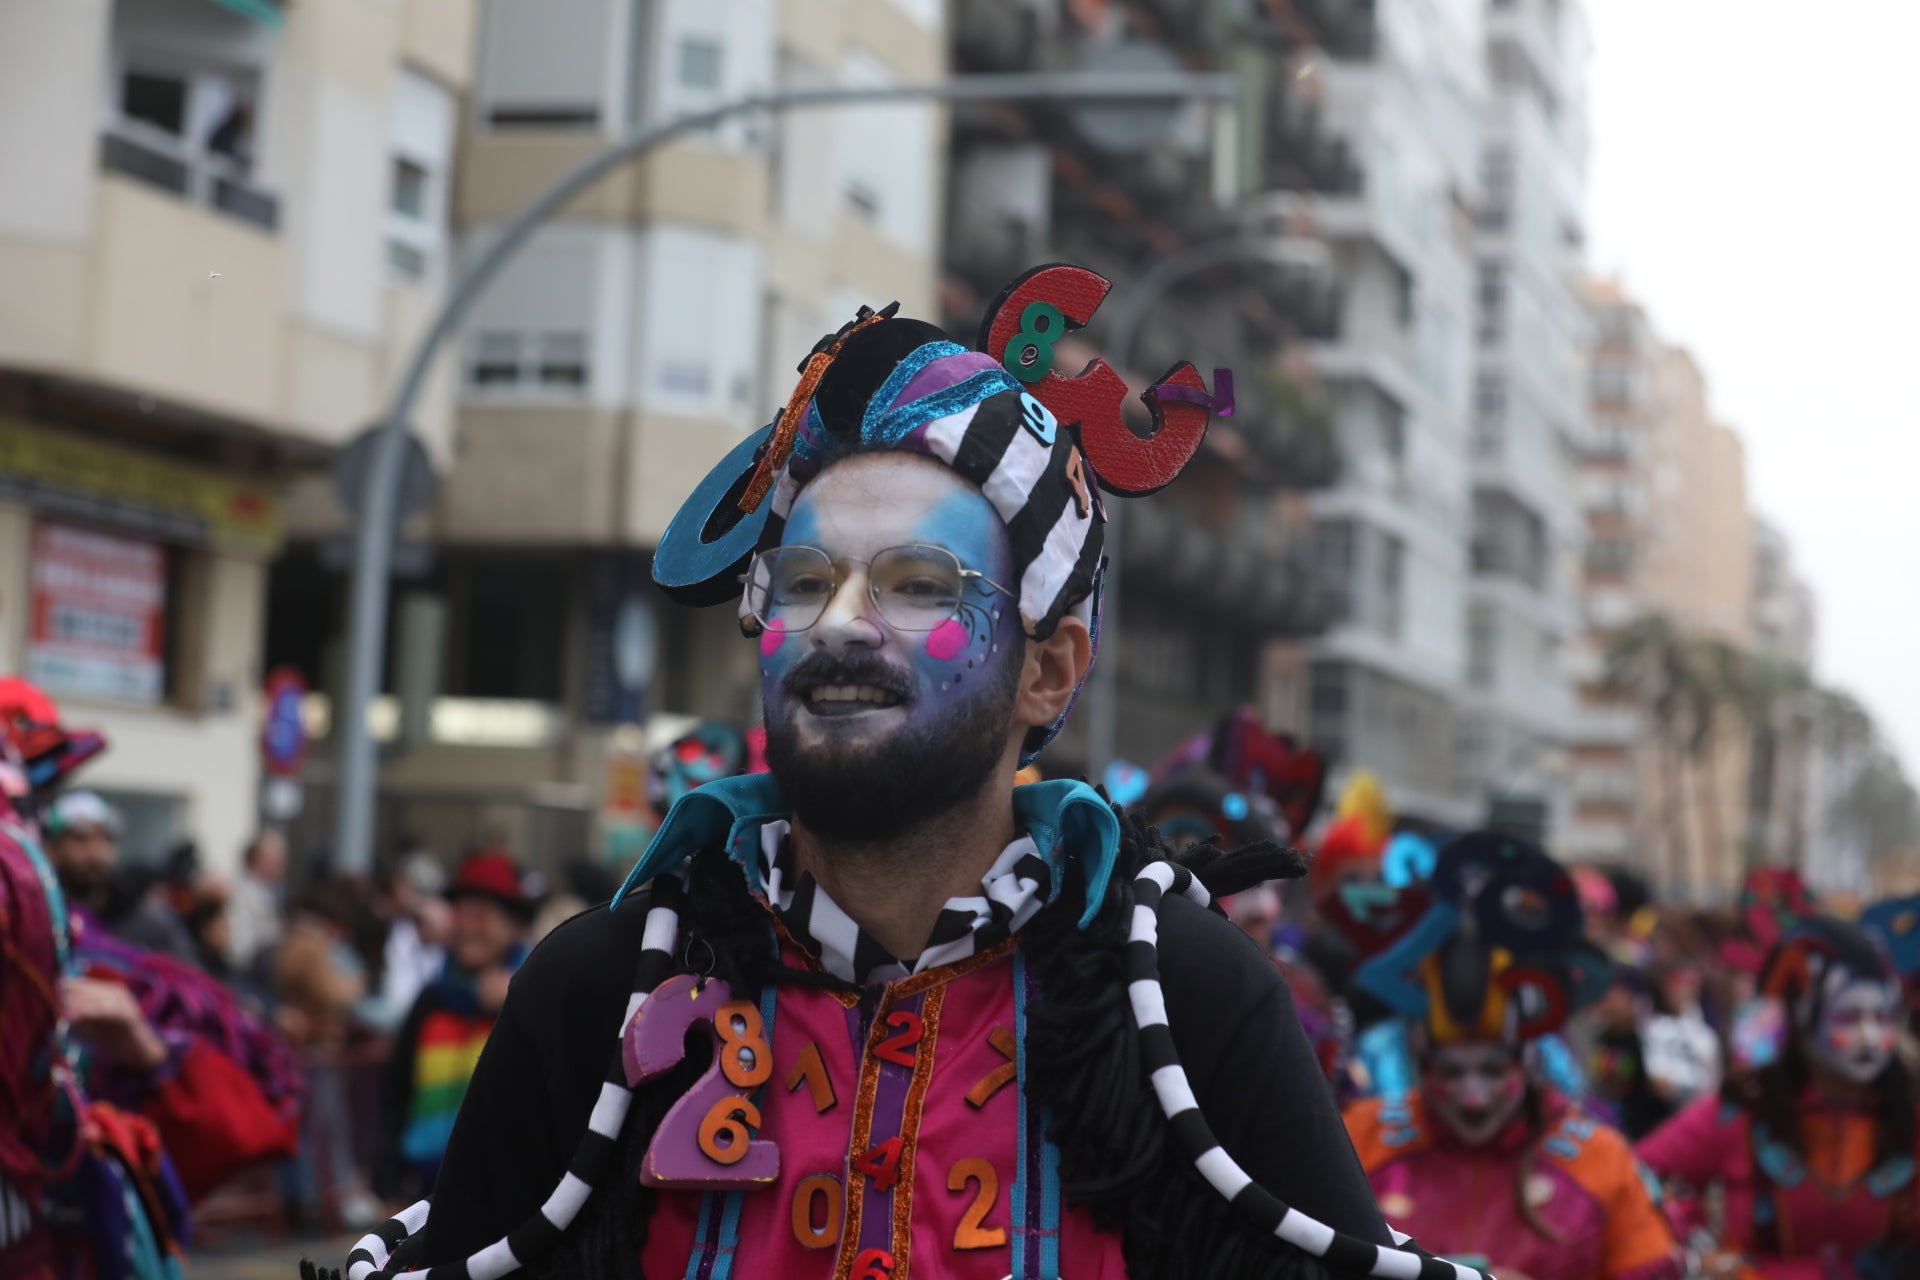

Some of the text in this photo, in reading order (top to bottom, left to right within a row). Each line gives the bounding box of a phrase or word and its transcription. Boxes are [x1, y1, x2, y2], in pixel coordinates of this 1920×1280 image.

[1003, 301, 1065, 382] 8
[714, 1000, 773, 1088] 8
[785, 1041, 838, 1114] 1
[874, 1011, 924, 1068] 2
[622, 973, 780, 1188] 2
[697, 1096, 762, 1166] 6
[854, 1136, 905, 1192] 4
[791, 1173, 843, 1249] 0
[947, 1158, 1007, 1250] 2
